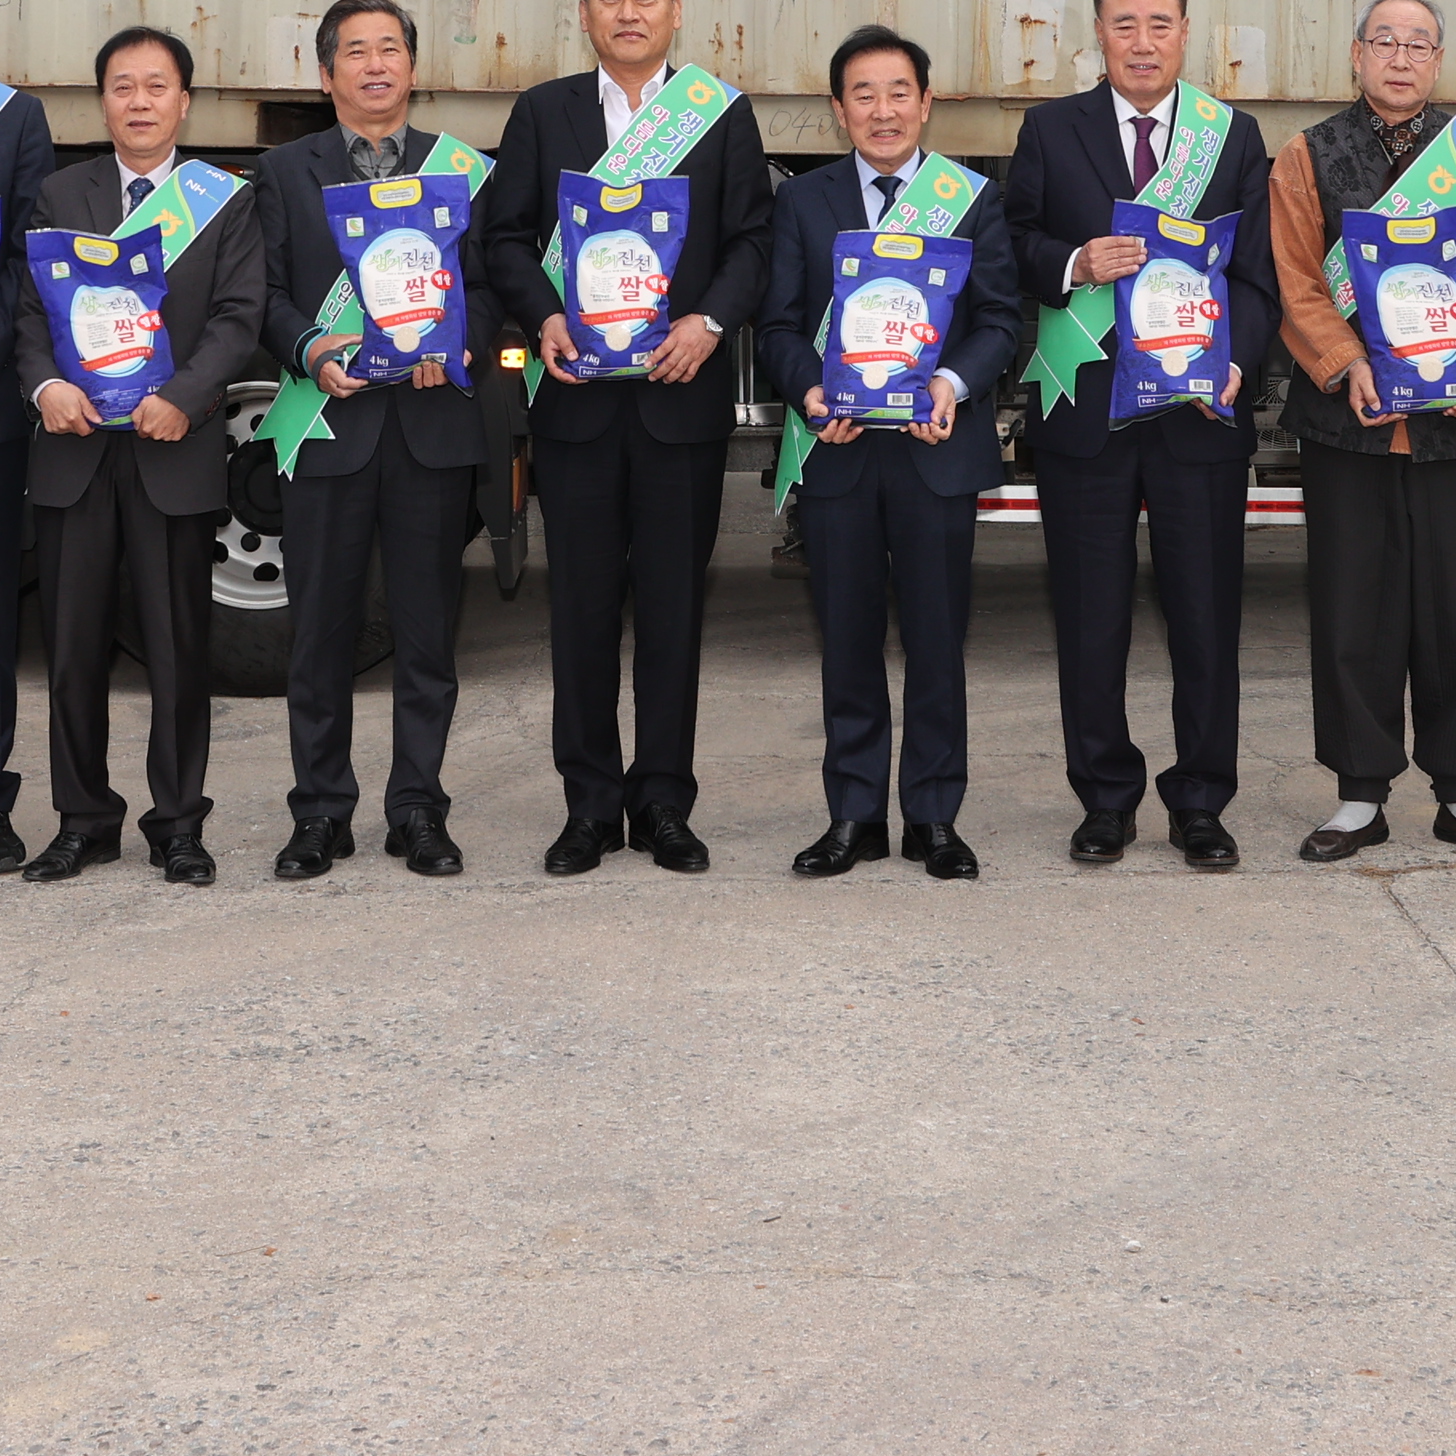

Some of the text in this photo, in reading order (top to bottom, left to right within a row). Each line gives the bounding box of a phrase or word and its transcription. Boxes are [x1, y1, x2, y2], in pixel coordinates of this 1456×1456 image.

[605, 104, 671, 176] 아름다운
[1153, 126, 1196, 202] 아름다운
[185, 178, 207, 195] NH
[403, 276, 428, 303] 쌀
[617, 275, 644, 302] 쌀
[1173, 300, 1197, 328] 쌀
[1424, 306, 1450, 333] 쌀
[112, 317, 137, 344] 쌀
[882, 320, 909, 346] 쌀
